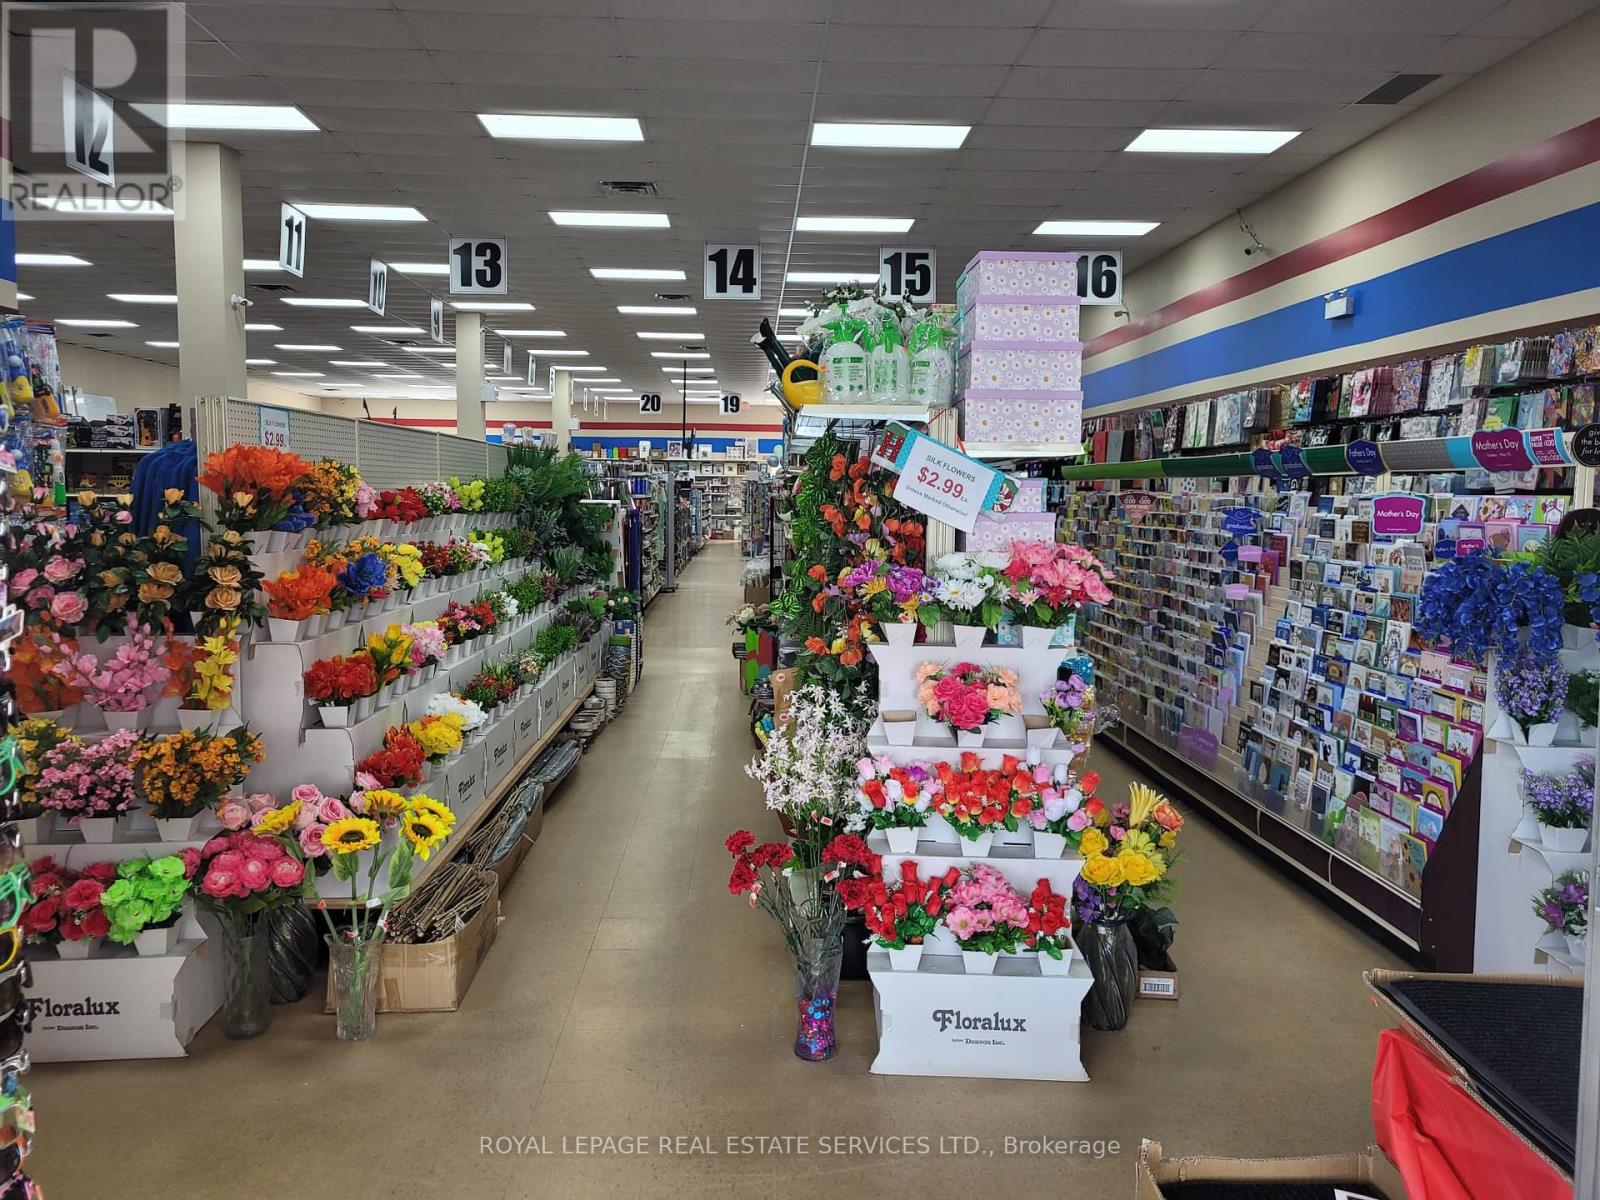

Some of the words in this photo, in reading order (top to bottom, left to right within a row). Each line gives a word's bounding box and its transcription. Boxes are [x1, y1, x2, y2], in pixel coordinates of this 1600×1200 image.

[285, 215, 303, 271] 11
[452, 242, 502, 289] 13
[708, 248, 757, 294] 14
[883, 251, 932, 297] 15
[1076, 254, 1118, 299] 16
[371, 271, 386, 311] 10
[432, 301, 441, 338] 9
[640, 394, 661, 412] 20
[721, 395, 740, 413] 19
[264, 430, 284, 448] $2.99
[1366, 447, 1376, 458] Day
[1475, 440, 1503, 451] Mother's
[1503, 438, 1519, 451] Day
[917, 466, 964, 500] $2.99
[926, 454, 942, 467] SILK
[942, 462, 976, 483] FLOWERS
[1376, 509, 1405, 518] Mother's
[1405, 509, 1420, 519] Day
[26, 996, 120, 1020] Floralux
[932, 1009, 1027, 1032] Floralux
